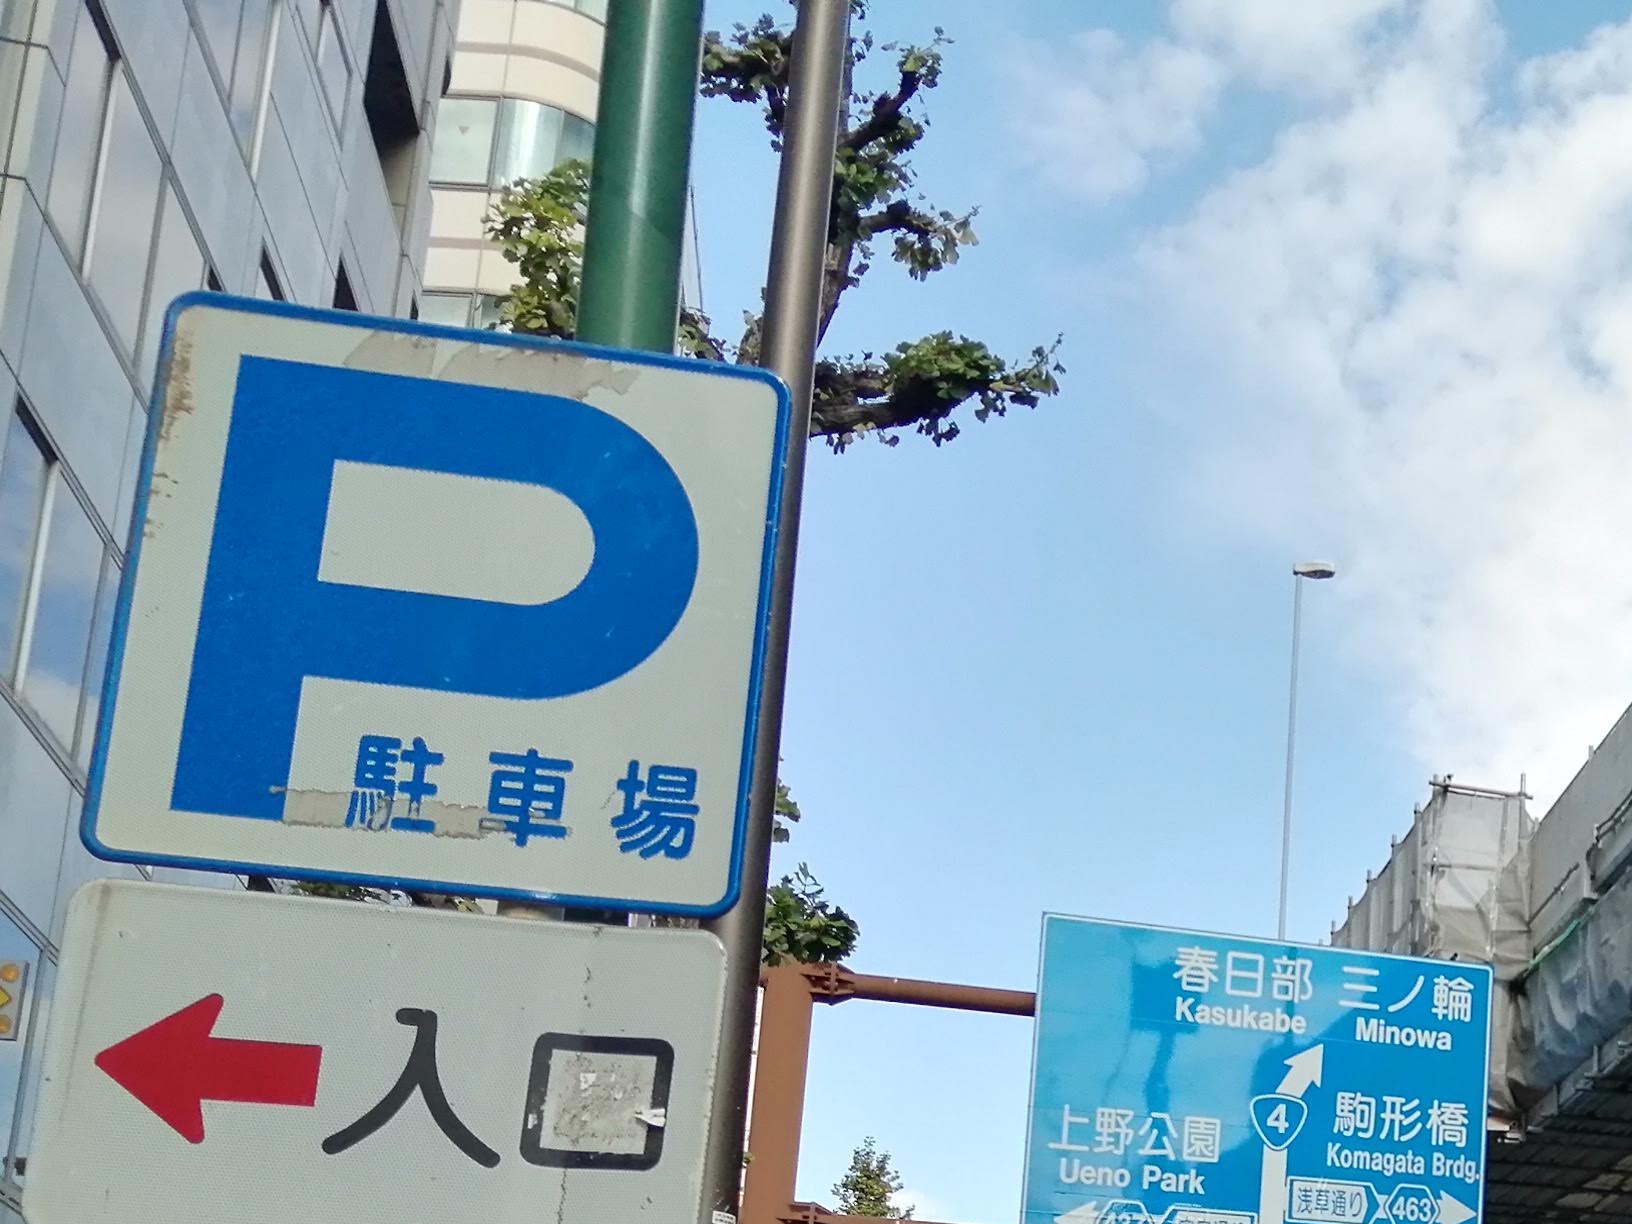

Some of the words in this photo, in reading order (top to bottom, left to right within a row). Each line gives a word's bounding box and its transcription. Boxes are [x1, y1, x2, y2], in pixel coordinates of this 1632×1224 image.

[170, 354, 699, 823] P
[345, 734, 700, 861] 駐車場
[1173, 947, 1313, 1004] 春日部
[1339, 964, 1474, 1023] 三ノ輪
[1175, 996, 1307, 1034] Kasukabe
[1355, 1016, 1452, 1051] Minowa
[322, 1009, 674, 1170] 入口
[1048, 1104, 1221, 1163] 上野公園
[1266, 1104, 1289, 1134] 4
[1333, 1091, 1469, 1147] 駒形橋
[1059, 1157, 1131, 1188] Ueno
[1142, 1164, 1205, 1195] Park
[1326, 1142, 1425, 1177] Komagata
[1432, 1152, 1480, 1184] Brdg.
[1296, 1186, 1364, 1219] 浅草通り
[1392, 1196, 1433, 1222] 463
